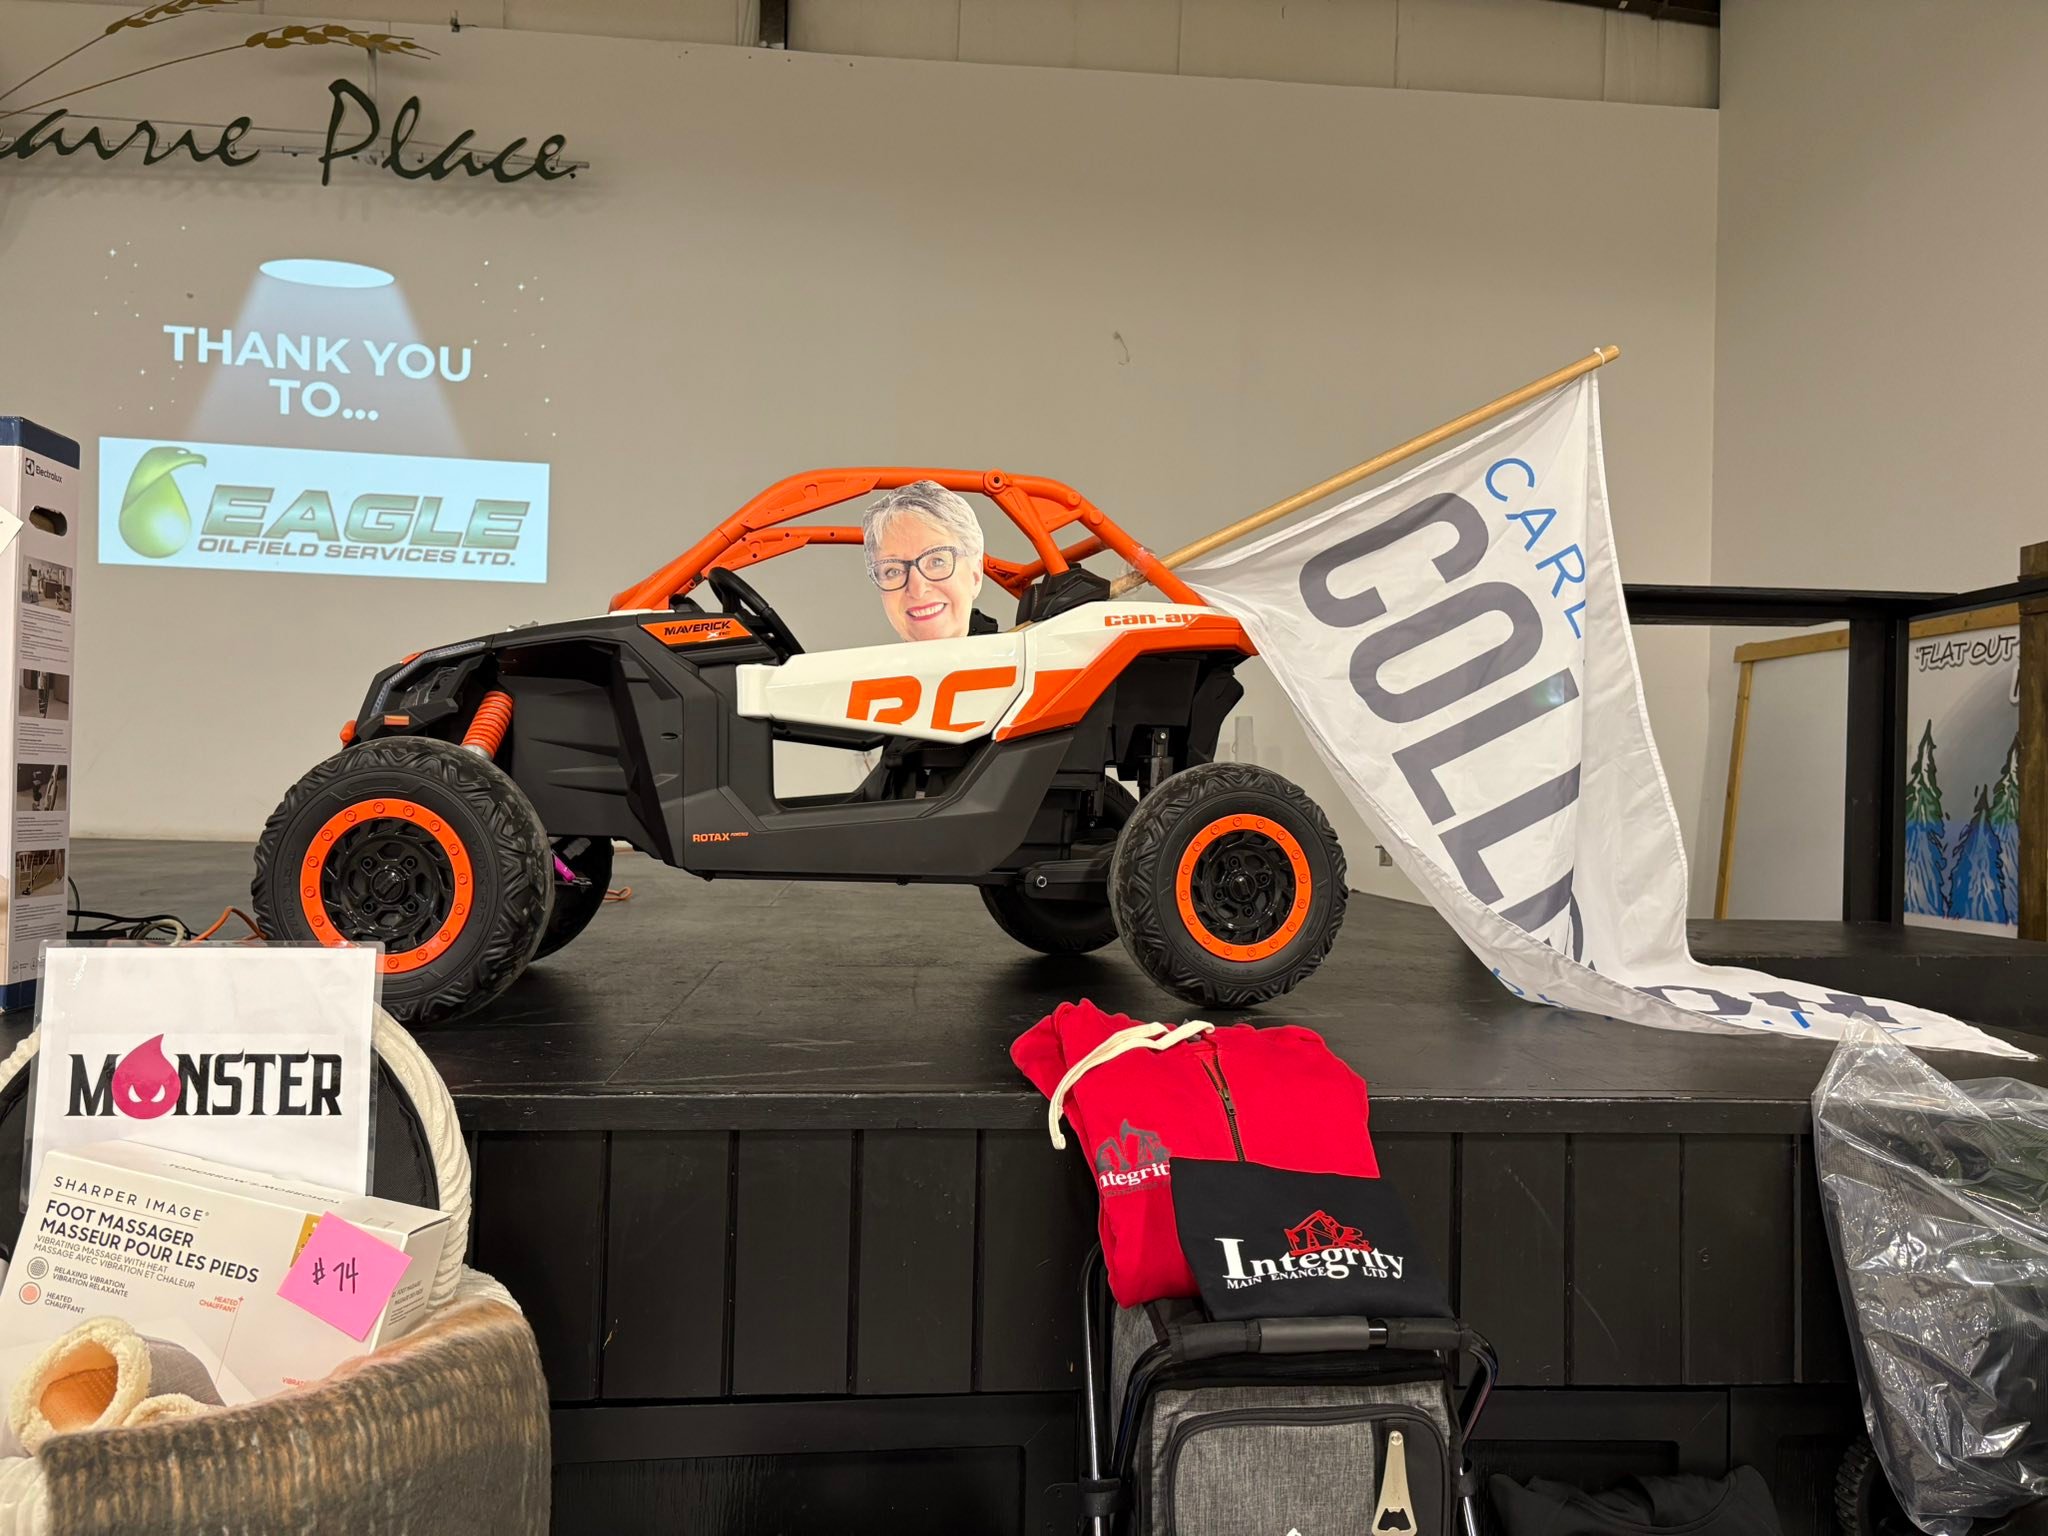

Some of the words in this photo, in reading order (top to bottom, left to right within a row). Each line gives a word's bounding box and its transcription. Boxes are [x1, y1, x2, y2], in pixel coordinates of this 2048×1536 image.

[319, 78, 577, 186] Place
[163, 325, 351, 374] THANK
[363, 340, 472, 382] YOU
[269, 378, 379, 421] TO...
[36, 465, 63, 483] Electrolux
[201, 484, 531, 550] EAGLE
[197, 537, 318, 557] OILFIELD
[324, 544, 457, 564] SERVICES
[462, 551, 516, 566] LTD.
[664, 620, 731, 636] MAVERICK
[1972, 634, 2017, 659] OUT
[692, 832, 730, 842] ROTAX
[1099, 1163, 1170, 1190] ntegrit
[53, 1176, 138, 1206] SHARPER
[45, 1199, 96, 1223] FOOT
[98, 1211, 194, 1248] MASSAGER
[37, 1234, 81, 1251] VIBRATING
[82, 1246, 122, 1263] MASSAGE
[124, 1256, 146, 1268] WITH
[147, 1262, 168, 1274] HEAT
[40, 1217, 122, 1250] MASSEUR
[124, 1238, 173, 1263] POUR
[175, 1250, 206, 1270] LES
[209, 1259, 260, 1283] PIEDS
[1214, 1237, 1404, 1280] Integrity
[33, 1243, 74, 1259] MASSAGE
[75, 1253, 98, 1266] AVEC
[99, 1259, 144, 1277] VIBRATION
[144, 1270, 155, 1279] ET
[156, 1273, 196, 1289] CHALEUR
[54, 1265, 88, 1280] RELAXING
[89, 1274, 126, 1289] VIBRATION
[1362, 1266, 1388, 1279] LTD
[46, 1291, 73, 1304] HEATED
[52, 1273, 88, 1287] VIBRATION
[88, 1282, 129, 1298] RELAXANTE
[44, 1299, 85, 1314] CHAUFFANT
[199, 1299, 237, 1312] CHAUFFANT
[214, 1295, 239, 1306] HEATED
